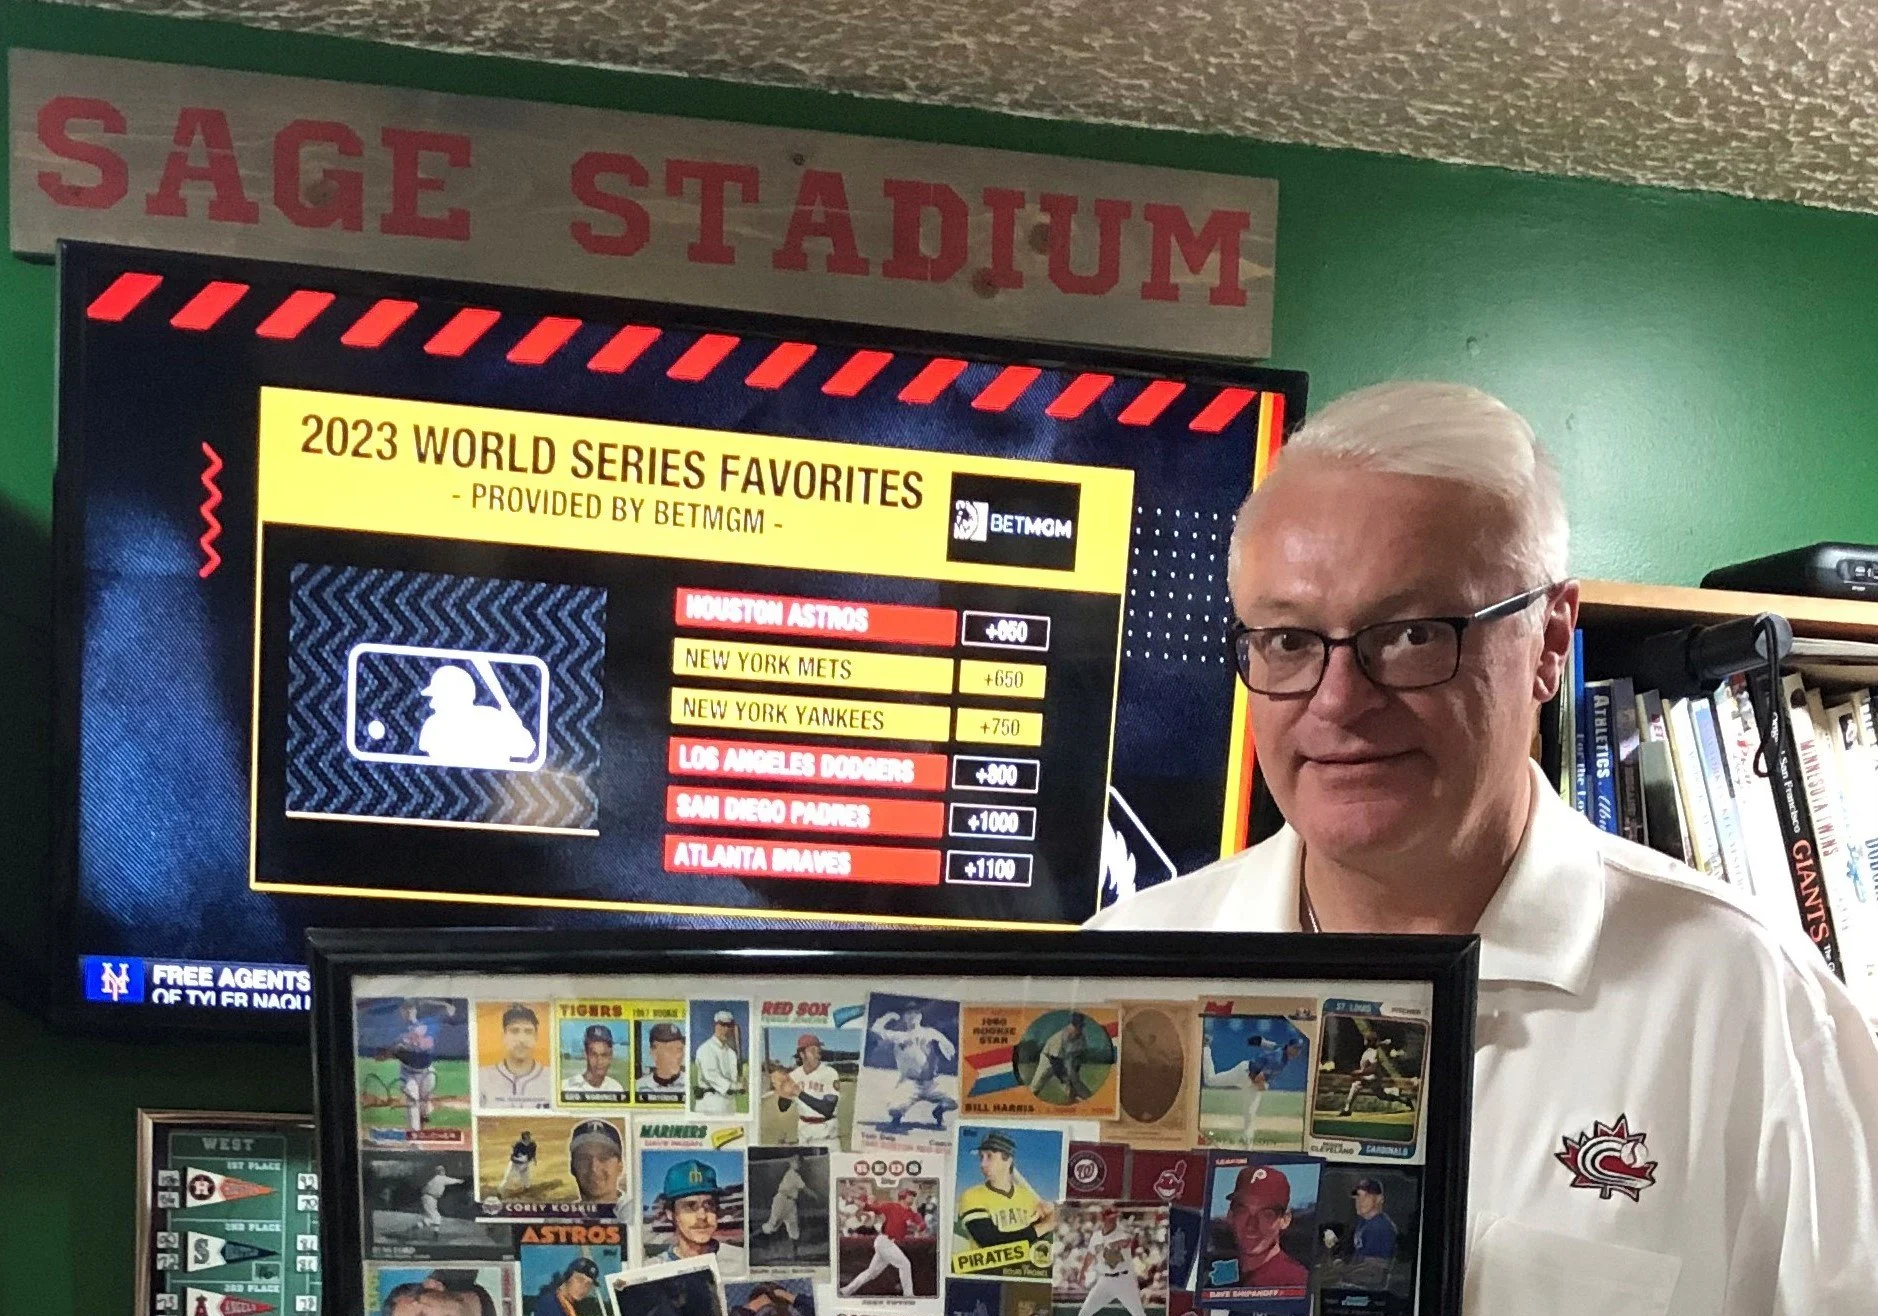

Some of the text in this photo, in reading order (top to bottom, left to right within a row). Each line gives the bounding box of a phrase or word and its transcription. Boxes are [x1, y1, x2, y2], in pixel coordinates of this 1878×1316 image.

[37, 96, 1252, 307] SAGE STADIUM
[301, 414, 924, 510] 2023 WORLD SERIES FAVORITES
[472, 483, 765, 535] PROVIDED BY BETMGM
[990, 513, 1073, 540] BETMGM
[686, 594, 869, 633] HOUSTON ASTROS
[685, 648, 852, 681] NEW YORK METS
[983, 669, 1024, 689] +650
[683, 697, 885, 731] NEW YORK YANKEES
[979, 717, 1021, 737] +750
[1592, 694, 1611, 779] ATHLETICS
[678, 746, 915, 784] LOS ANGELES DODGERS
[1576, 763, 1586, 787] the
[676, 794, 871, 829] SAN DIEGO PADRES
[968, 812, 1019, 834] +1000
[673, 842, 852, 875] ATLANTA BRAVES
[964, 858, 1016, 881] +1100
[1778, 757, 1833, 962] San Francisco GIANTS The
[152, 964, 311, 991] FREE AGENTS
[558, 1003, 623, 1018] TIGERS
[761, 1001, 832, 1017] RED SOX
[979, 1035, 1009, 1045] STAR
[639, 1124, 708, 1138] MARINERS
[203, 1137, 255, 1150] WEST
[248, 1162, 281, 1172] PLACE
[505, 1203, 598, 1213] COREY KOSKIE
[248, 1223, 281, 1233] PLACE
[520, 1225, 621, 1245] ASTROS
[957, 1245, 1025, 1269] PIRATES
[247, 1283, 280, 1293] PLACE
